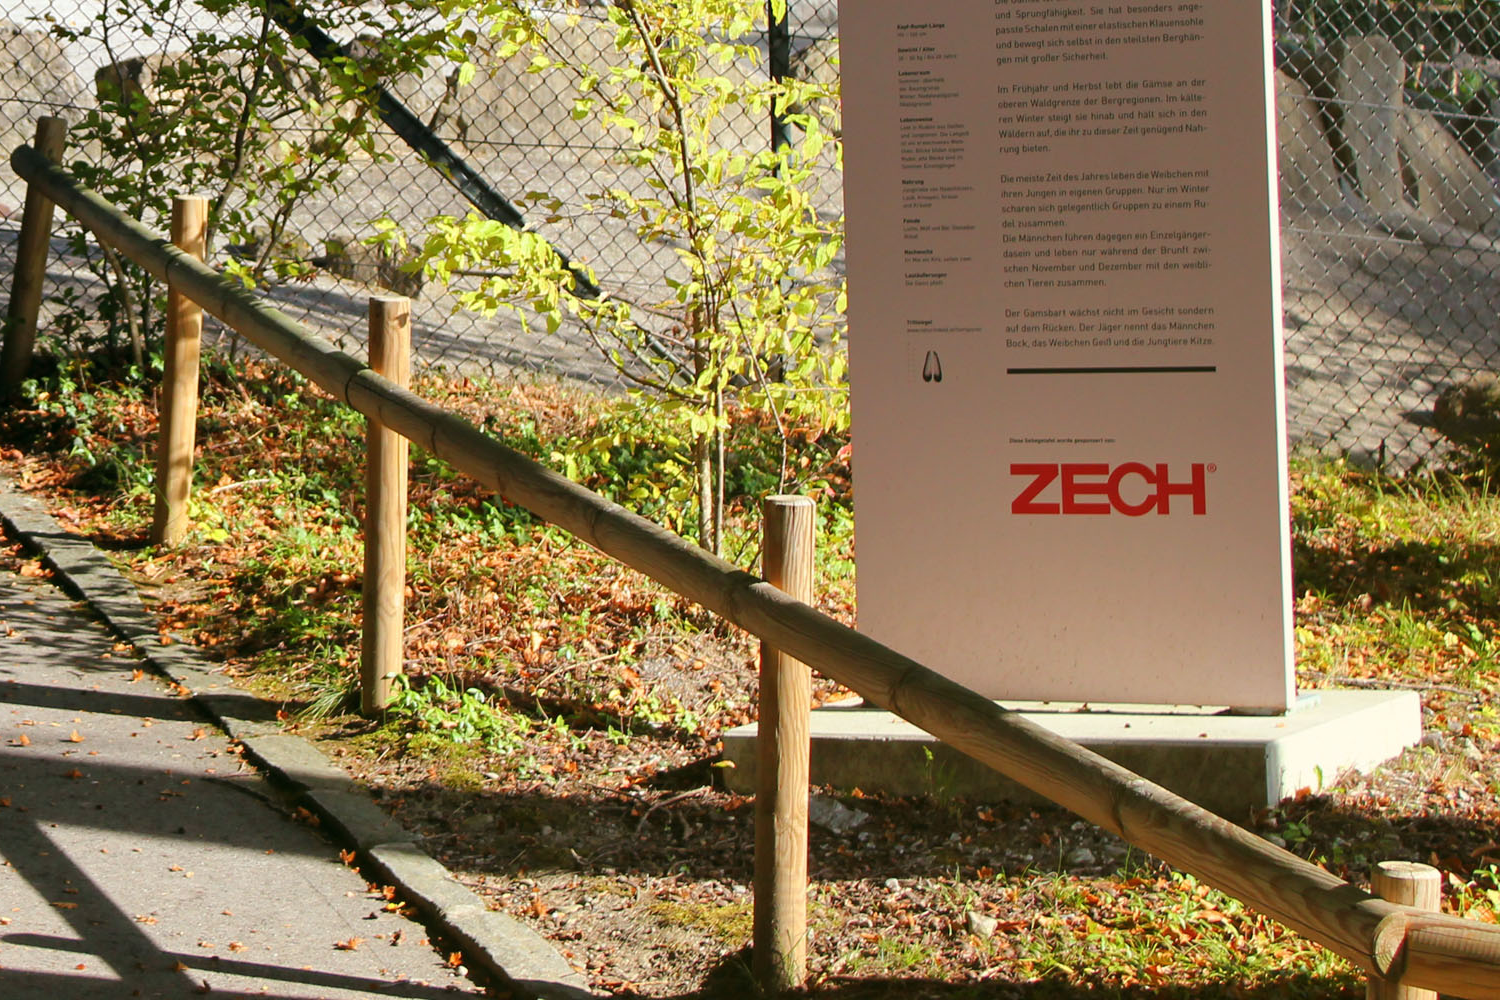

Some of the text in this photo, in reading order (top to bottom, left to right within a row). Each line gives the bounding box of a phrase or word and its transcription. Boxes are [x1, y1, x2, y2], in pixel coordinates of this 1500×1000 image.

[994, 10, 1011, 19] und
[1090, 6, 1103, 15] Sie
[1108, 6, 1122, 14] hat
[1126, 4, 1172, 13] besonders
[1177, 4, 1202, 12] ange-
[995, 17, 1203, 35] passte Schalen mit einer elastischen Klauensohle
[995, 40, 1012, 49] und
[1013, 40, 1044, 49] bewegt
[1046, 38, 1064, 47] sich
[1066, 37, 1092, 46] selbst
[1104, 36, 1121, 44] den
[1122, 35, 1160, 43] steilsten
[996, 57, 1012, 66] gen
[1030, 53, 1060, 64] großer
[997, 85, 1008, 93] Im
[1012, 84, 1048, 94] Frühjahr
[1052, 82, 1068, 91] und
[1072, 82, 1101, 90] Herbst
[1105, 81, 1122, 89] lebt
[1125, 80, 1138, 88] die
[1142, 79, 1172, 88] Gämse
[1190, 78, 1205, 86] der
[997, 100, 1027, 108] oberen
[1030, 98, 1080, 108] Waldgrenze
[1083, 97, 1098, 105] der
[1165, 94, 1177, 102] Im
[1015, 114, 1044, 122] Winter
[1047, 113, 1071, 123] steigt
[1075, 112, 1087, 120] sie
[1090, 112, 1114, 120] hinab
[1117, 111, 1134, 119] und
[1137, 110, 1154, 118] hält
[1158, 109, 1175, 118] sich
[1190, 108, 1207, 117] den
[998, 129, 1035, 138] Wäldern
[1053, 128, 1066, 136] die
[1093, 127, 1120, 135] dieser
[1122, 125, 1138, 134] Zeit
[1140, 124, 1183, 135] genügend
[1184, 123, 1206, 132] Nah-
[999, 146, 1019, 155] rung
[1000, 174, 1014, 183] Die
[1045, 173, 1062, 182] Zeit
[1062, 173, 1079, 181] des
[1080, 172, 1110, 180] Jahres
[1110, 172, 1135, 180] leben
[1136, 171, 1149, 179] die
[1150, 170, 1193, 178] Weibchen
[1194, 169, 1208, 177] mit
[1002, 234, 1016, 243] Die
[1018, 234, 1063, 242] Männchen
[1064, 233, 1093, 241] führen
[1095, 233, 1132, 242] dagegen
[1002, 249, 1030, 258] dasein
[1034, 248, 1050, 257] und
[1054, 248, 1078, 256] leben
[1099, 247, 1138, 255] während
[1141, 246, 1156, 255] der
[1160, 245, 1188, 254] Brunft
[1003, 264, 1028, 272] schen
[1031, 263, 1076, 272] November
[1078, 262, 1095, 271] und
[1098, 262, 1142, 271] Dezember
[1163, 261, 1179, 269] den
[1181, 260, 1211, 269] weibli-
[1004, 308, 1020, 317] Der
[1023, 308, 1066, 317] Gamsbart
[1068, 308, 1099, 316] wächst
[1102, 307, 1124, 315] nicht
[1141, 306, 1174, 315] Gesicht
[1177, 306, 1214, 314] sondern
[1005, 324, 1018, 332] auf
[1021, 324, 1040, 332] dem
[1078, 322, 1094, 331] Der
[1098, 323, 1122, 333] Jäger
[1123, 322, 1148, 330] nennt
[1151, 322, 1167, 330] das
[1168, 321, 1214, 330] Männchen
[1010, 462, 1206, 517] ZECH
